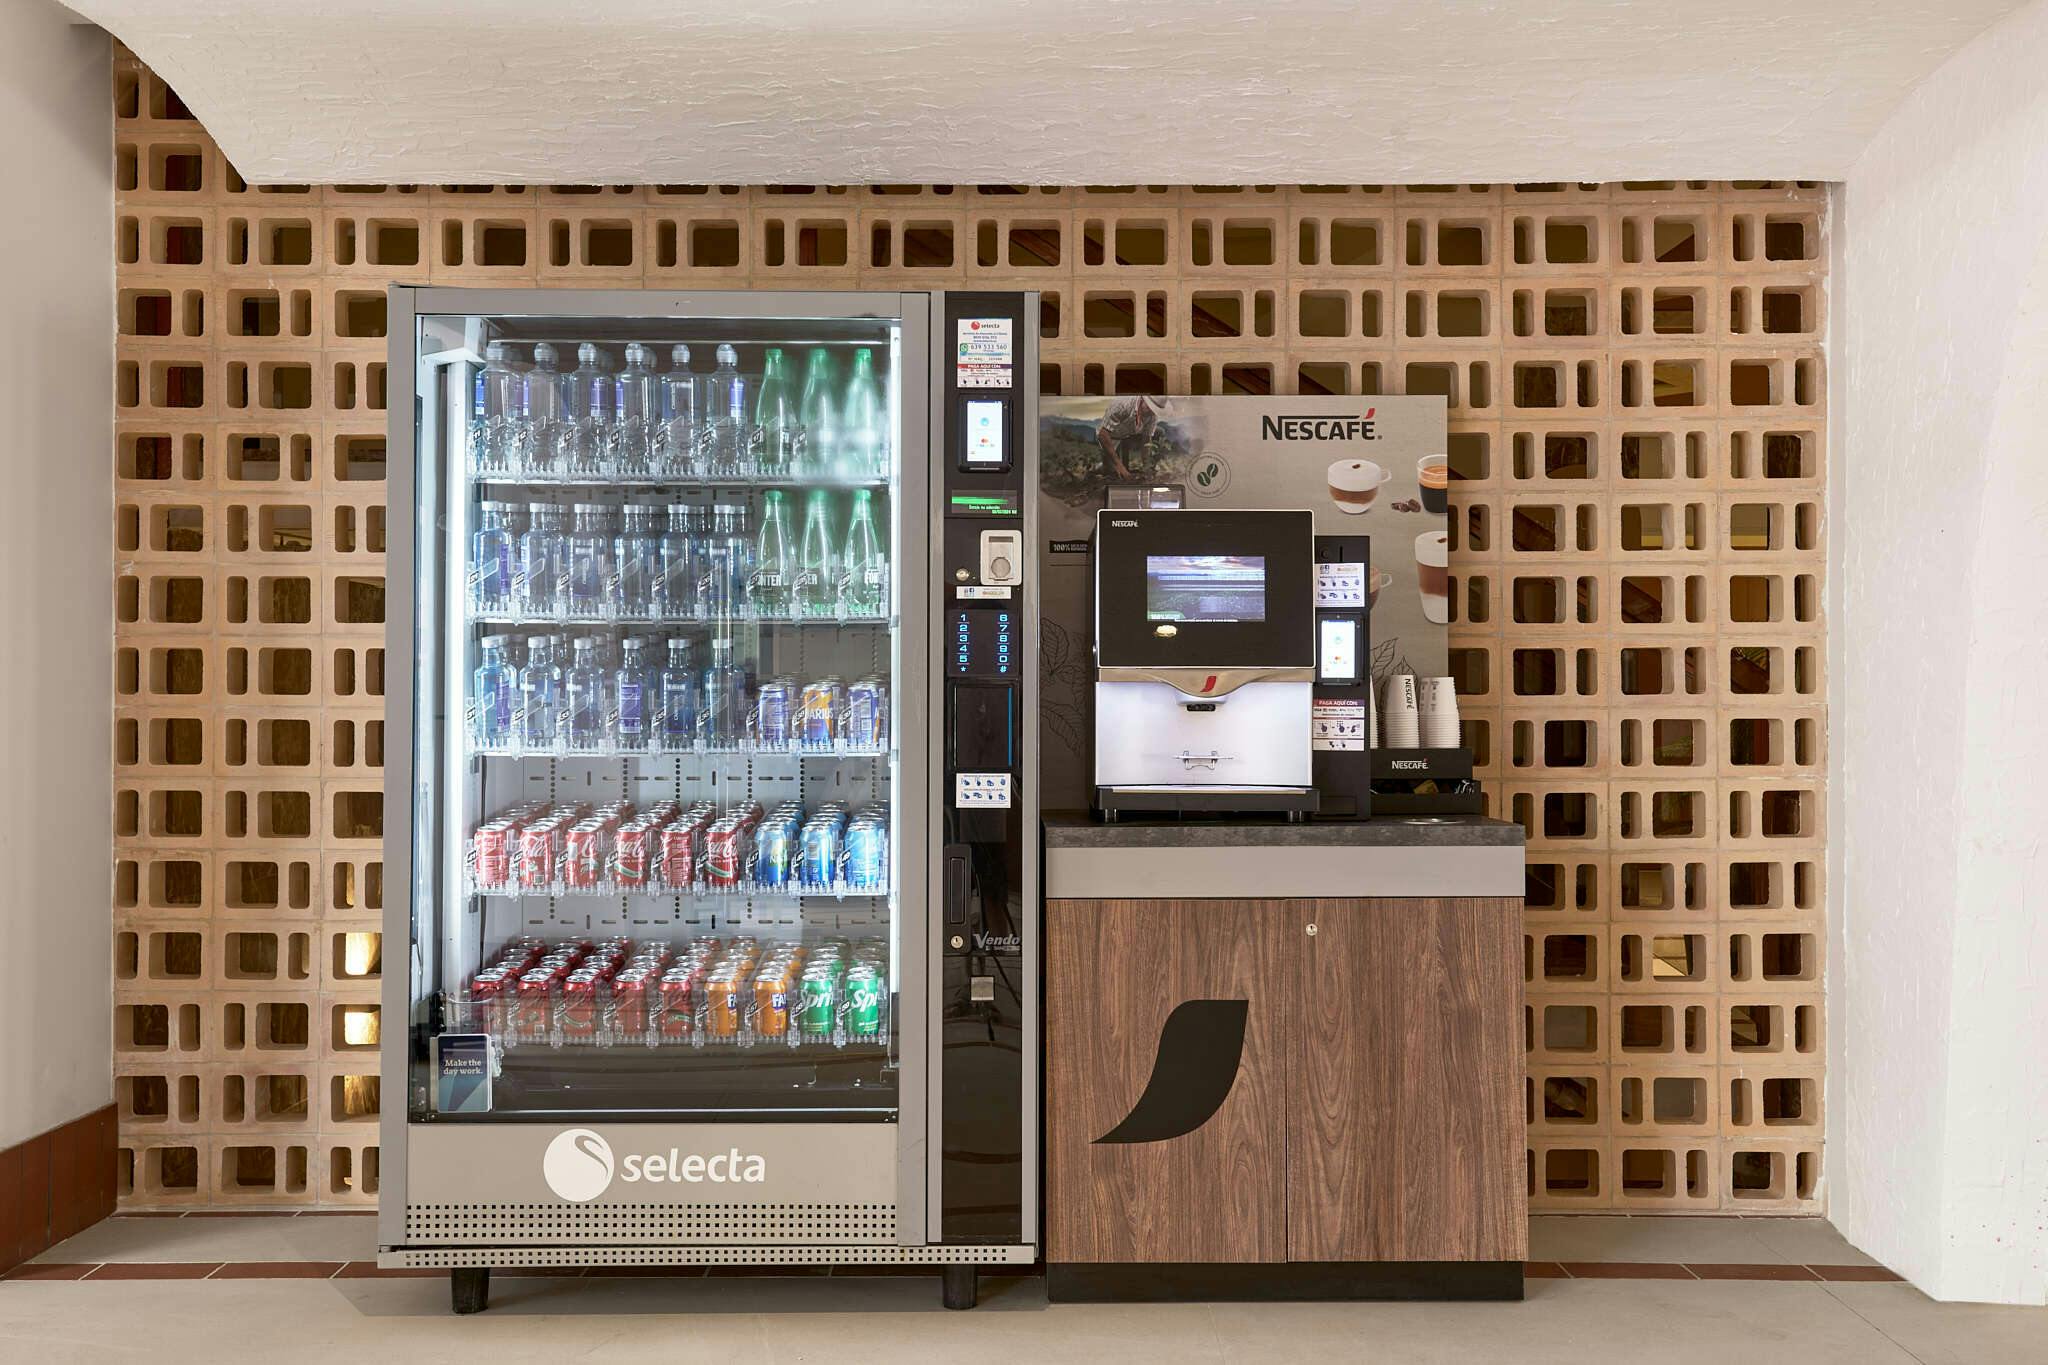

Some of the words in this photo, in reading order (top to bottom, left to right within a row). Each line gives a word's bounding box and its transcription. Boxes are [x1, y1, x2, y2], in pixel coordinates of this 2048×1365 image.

[1000, 614, 1007, 622] 6
[960, 624, 967, 632] 2
[972, 930, 1020, 949] Vendo
[443, 1067, 458, 1076] day
[620, 1147, 766, 1183] selecta
